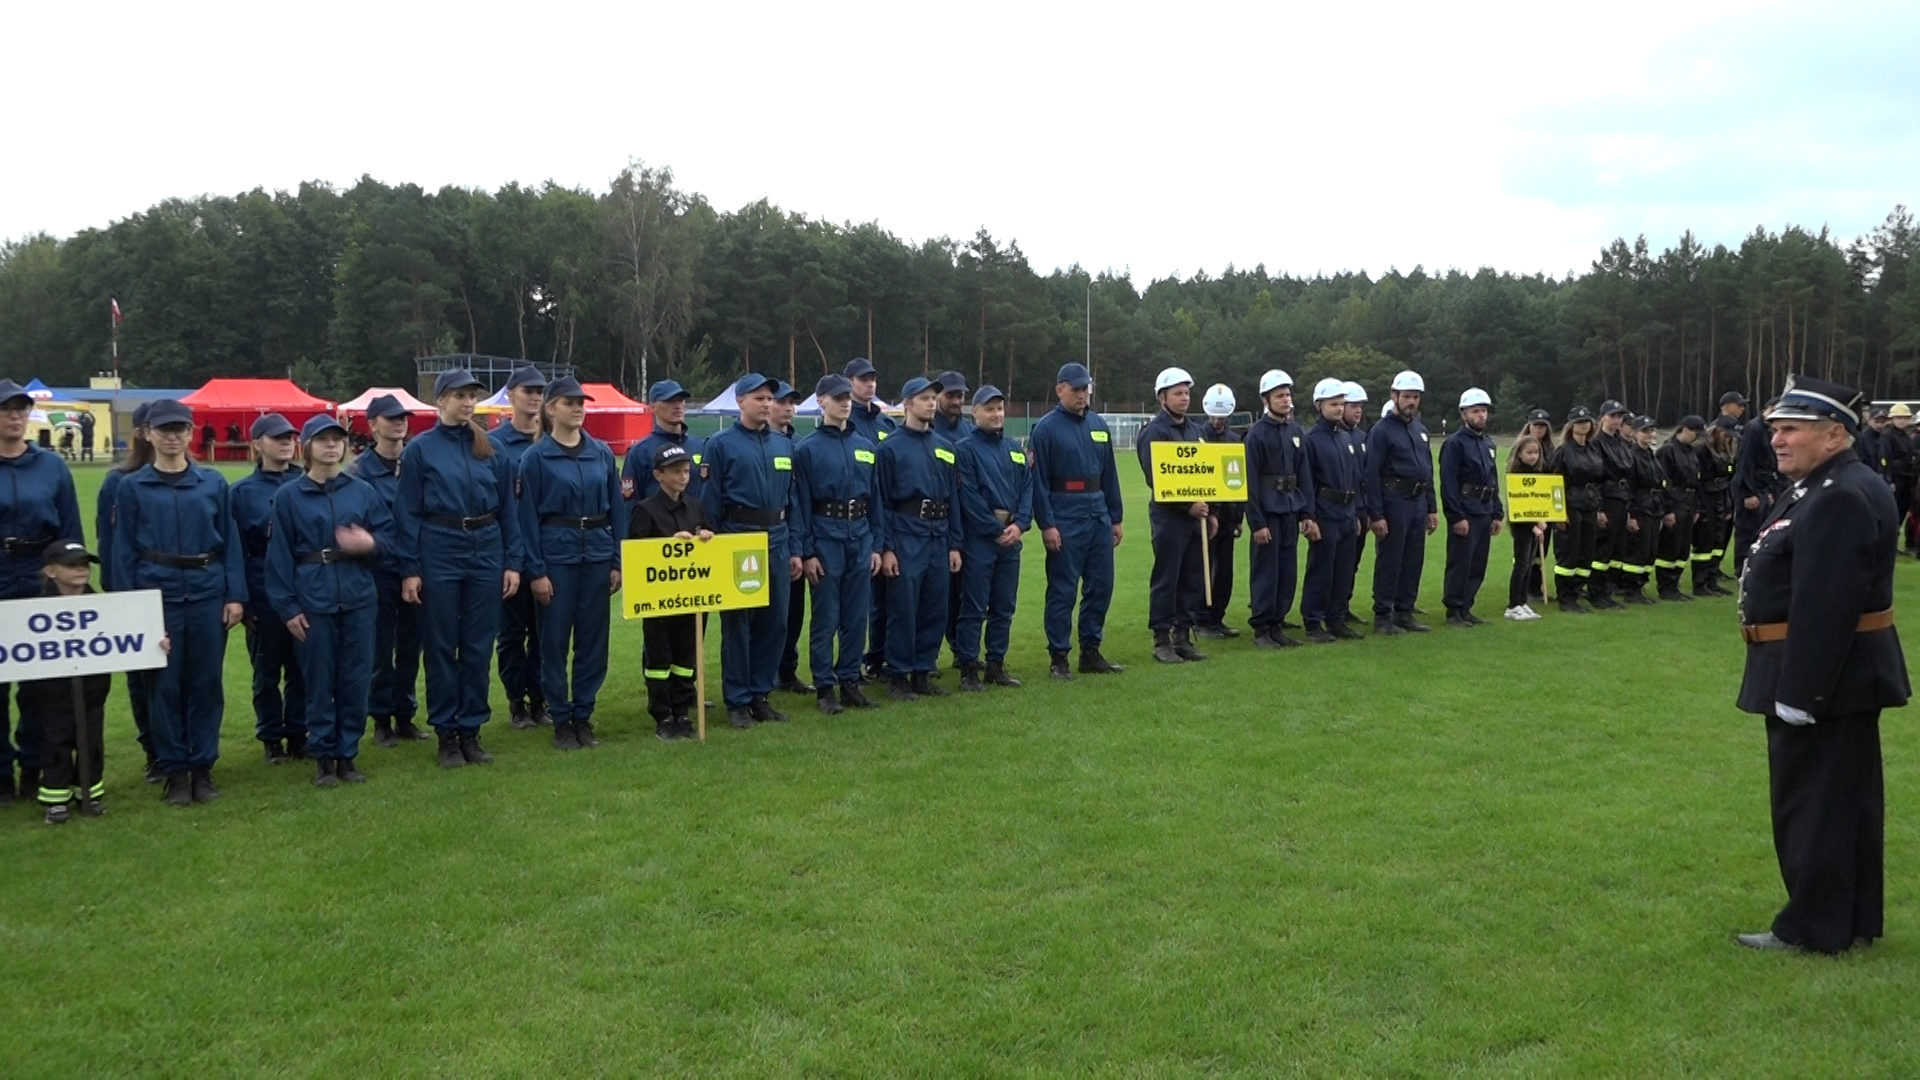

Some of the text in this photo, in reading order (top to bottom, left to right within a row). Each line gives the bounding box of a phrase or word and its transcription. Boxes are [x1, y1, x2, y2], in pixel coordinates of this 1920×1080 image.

[1176, 446, 1198, 458] OSP
[1160, 461, 1215, 474] Straszków
[1522, 477, 1537, 487] OSP
[662, 543, 695, 558] OSP
[646, 562, 712, 584] Dobrów
[634, 594, 723, 614] gm. KOŚCIELEC
[28, 610, 99, 634] OSP
